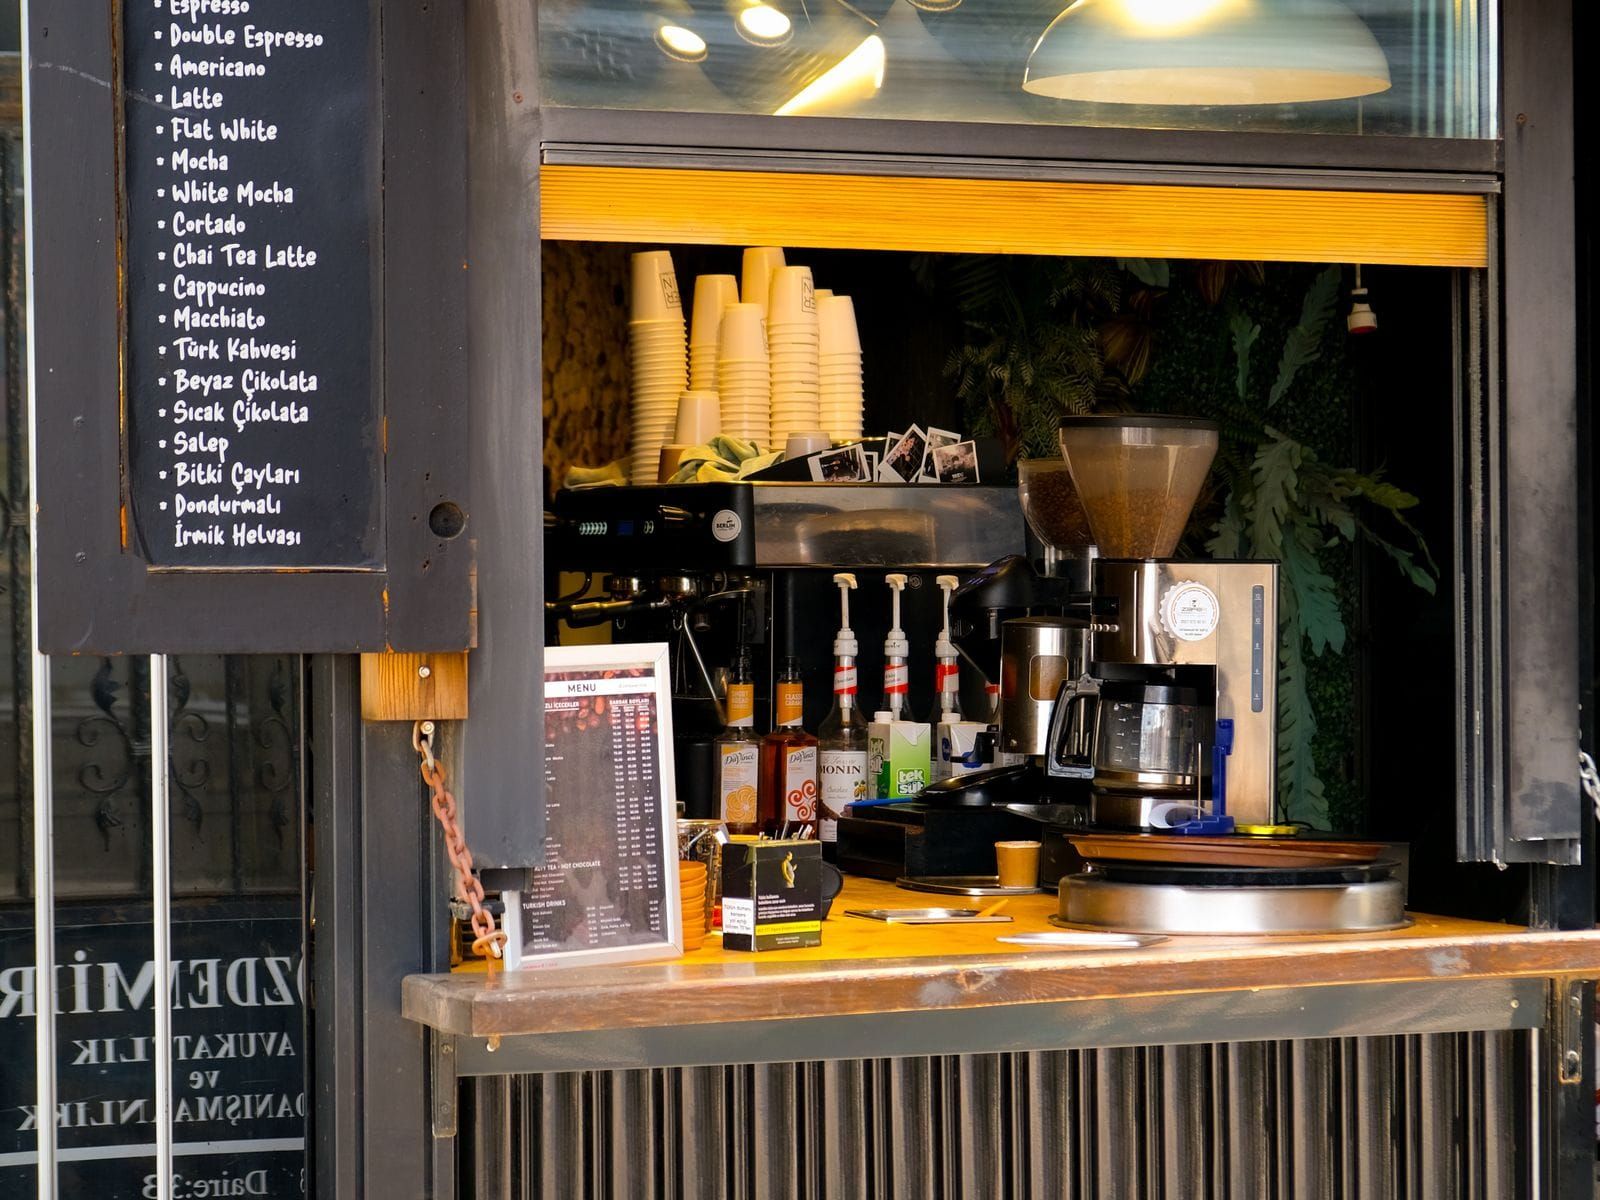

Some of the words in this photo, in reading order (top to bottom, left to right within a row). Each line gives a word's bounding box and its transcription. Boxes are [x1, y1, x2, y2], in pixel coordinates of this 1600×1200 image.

[170, 0, 250, 24] Espresso
[170, 23, 236, 47] Double
[243, 25, 324, 57] Espresso
[169, 54, 266, 79] Americano
[171, 86, 224, 109] Latte
[170, 117, 214, 142] Flat
[220, 118, 278, 141] White
[171, 148, 229, 173] Mocha
[171, 180, 229, 203] White
[236, 181, 294, 206] Mocha
[172, 211, 246, 236] Cortado
[172, 243, 213, 268] Chai
[219, 244, 257, 266] Tea
[265, 245, 317, 268] Latte
[173, 274, 266, 307] Cappucino
[173, 306, 266, 331] Macchiato
[172, 337, 220, 360] Türk
[227, 338, 297, 362] Kahvesi
[173, 369, 234, 396] Beyaz
[241, 369, 318, 405] Çikolata
[173, 400, 225, 424] Sıcak
[232, 400, 309, 432] Çikolata
[173, 431, 229, 463] Salep
[173, 462, 223, 486] Bitki
[231, 462, 300, 494] Çayları
[174, 493, 281, 517] Dondurmalı
[174, 520, 225, 547] İrmik
[231, 523, 301, 547] Helvası
[568, 683, 596, 693] MENU
[899, 770, 923, 783] tek
